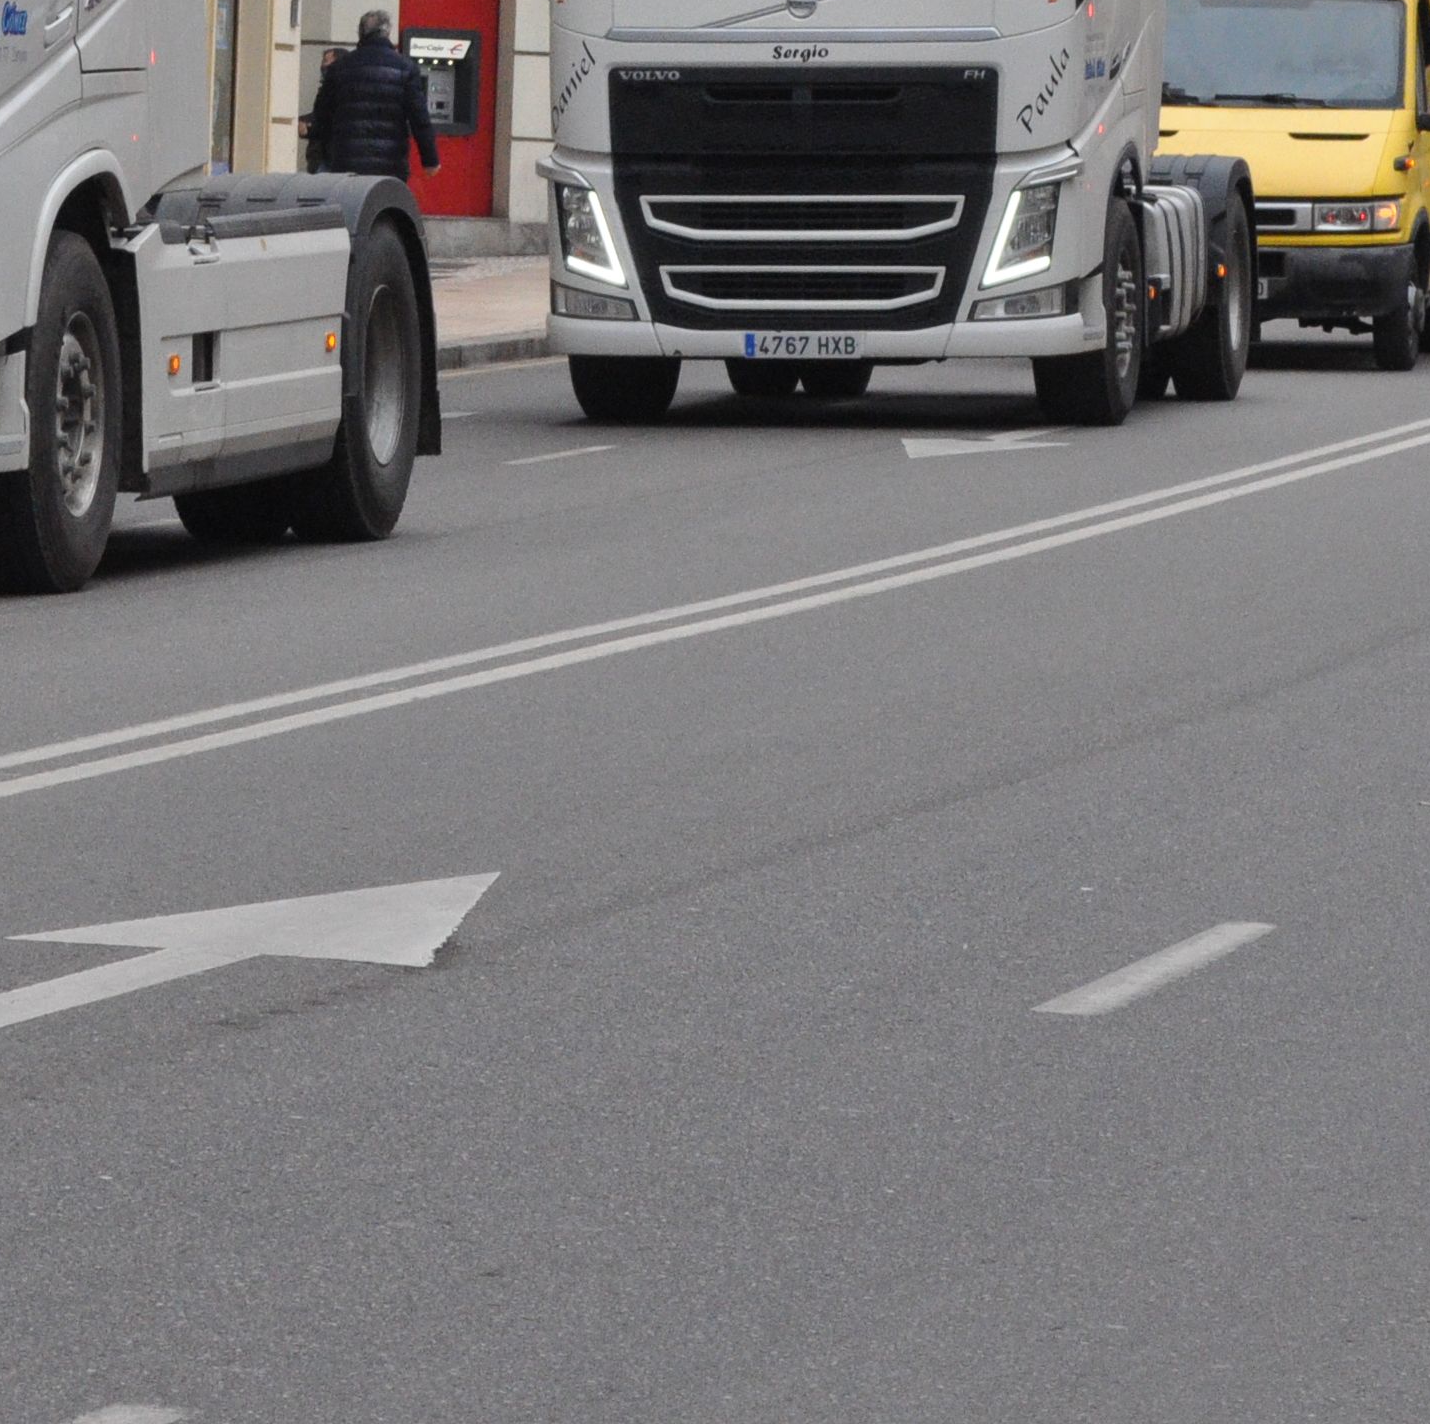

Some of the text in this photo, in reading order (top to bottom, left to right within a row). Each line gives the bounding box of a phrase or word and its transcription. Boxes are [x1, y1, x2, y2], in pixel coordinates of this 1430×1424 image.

[772, 44, 829, 63] Sergio
[619, 70, 680, 80] VOLVO
[963, 69, 985, 80] FH
[552, 40, 595, 134] Daniel
[1016, 48, 1069, 134] Paula
[759, 336, 855, 355] 4767 HXB
